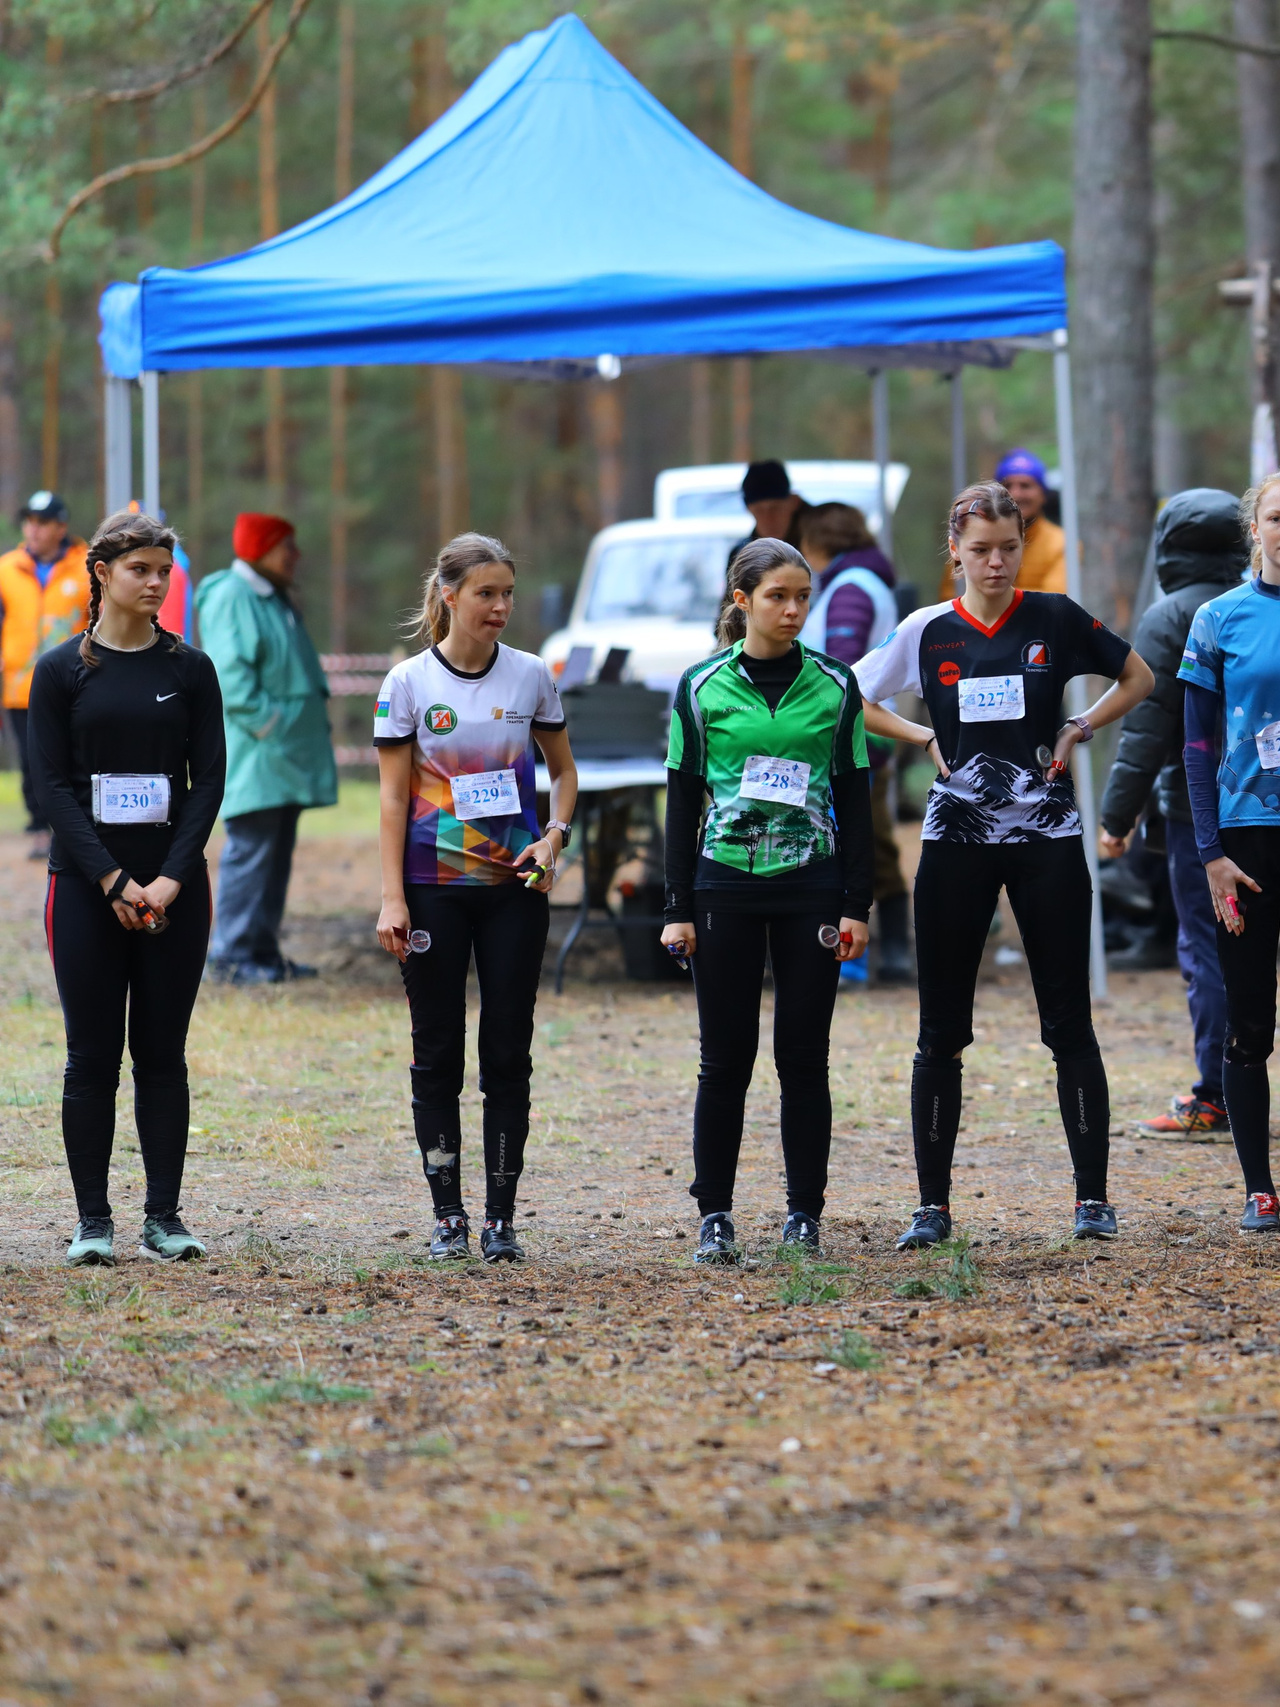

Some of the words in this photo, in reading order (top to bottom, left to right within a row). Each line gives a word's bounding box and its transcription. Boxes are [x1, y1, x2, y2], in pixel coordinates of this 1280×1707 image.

[977, 692, 1005, 707] 227
[761, 772, 789, 789] 228
[120, 794, 149, 808] 230
[471, 787, 499, 804] 229
[931, 1095, 939, 1130] NORD
[1077, 1087, 1086, 1122] NORD
[498, 1132, 506, 1173] NORD
